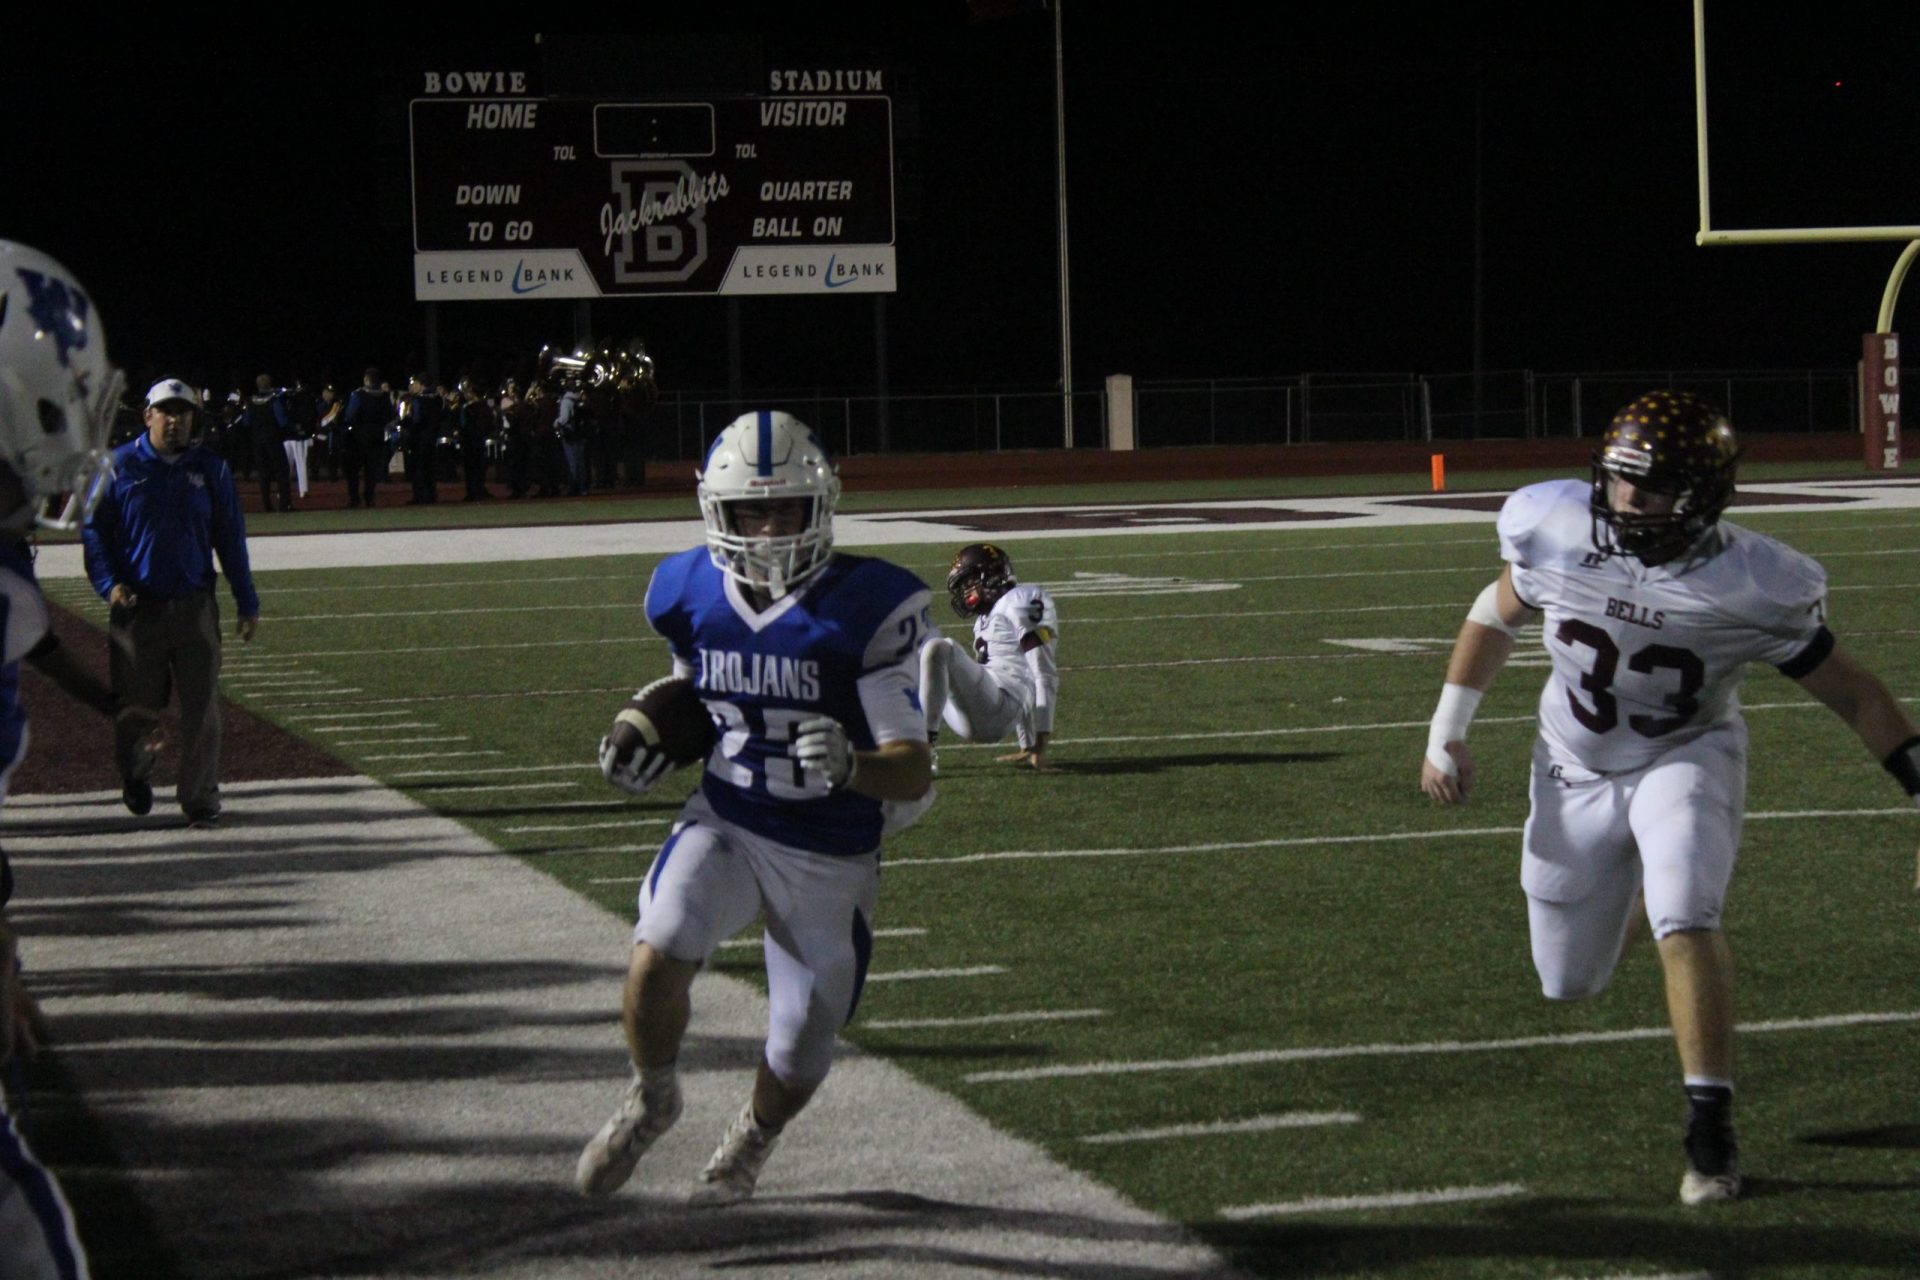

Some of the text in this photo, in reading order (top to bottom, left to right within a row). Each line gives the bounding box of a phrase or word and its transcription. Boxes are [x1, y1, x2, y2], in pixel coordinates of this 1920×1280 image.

[424, 69, 884, 93] BOWIE STADIUM
[467, 103, 538, 129] HOME
[760, 101, 848, 127] VISITOR
[552, 145, 577, 161] TOL
[735, 143, 758, 159] TOL
[455, 184, 522, 206] DOWN
[759, 180, 853, 202] QUARTER
[600, 170, 730, 257] Jackrabbits
[467, 220, 534, 242] TO GO
[752, 216, 843, 238] BALL ON
[427, 267, 574, 284] LEGEND BANK
[743, 262, 885, 278] LEGEND BANK
[1877, 337, 1901, 469] BOWIE
[1604, 597, 1665, 631] BELLS
[698, 648, 820, 701] TROJANS
[1555, 618, 1705, 739] 33
